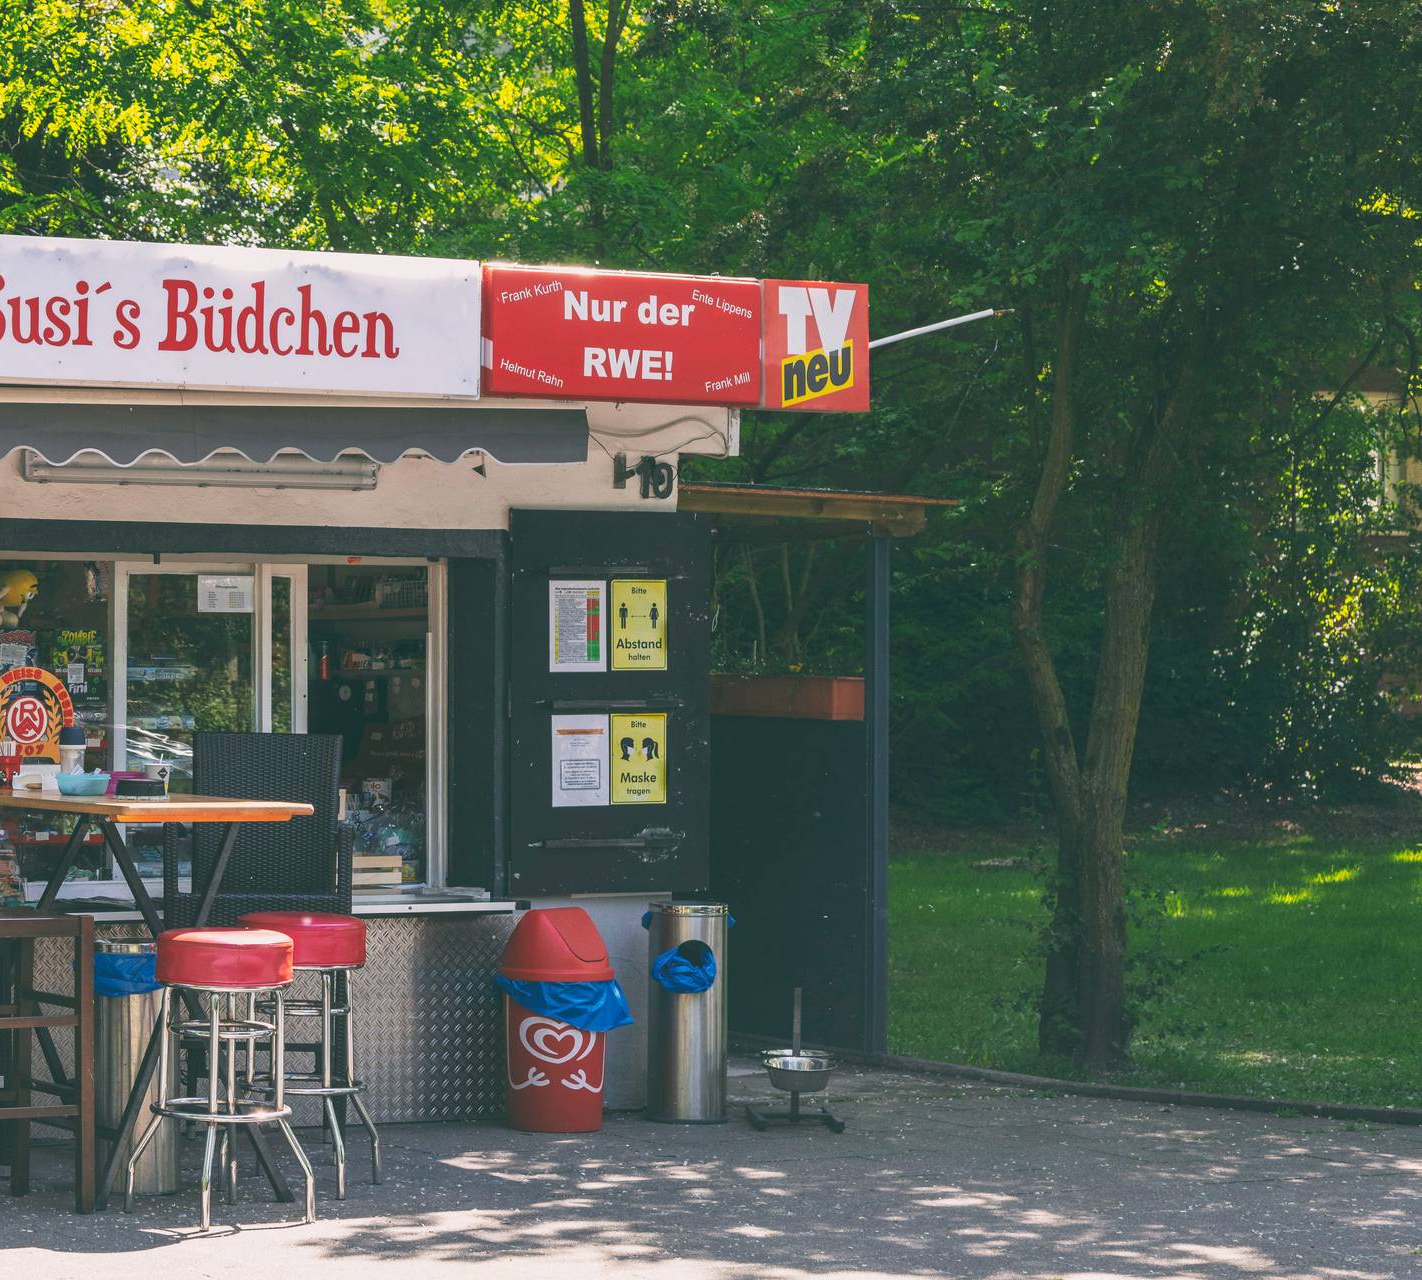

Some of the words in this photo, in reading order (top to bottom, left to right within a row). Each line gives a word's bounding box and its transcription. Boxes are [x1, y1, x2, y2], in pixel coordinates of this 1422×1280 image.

[501, 289, 533, 304] Frank
[534, 280, 563, 297] Kurth
[692, 289, 714, 306] Ente
[716, 297, 753, 319] Lippens
[158, 279, 400, 359] Büdchen
[564, 290, 628, 323] Nur
[638, 294, 695, 327] der
[779, 286, 856, 356] TV
[500, 358, 536, 379] Helmut
[537, 370, 564, 388] Rahn
[583, 347, 673, 381] RWE!
[784, 347, 851, 401] neu
[705, 377, 733, 393] Frank
[734, 371, 751, 386] Mill
[631, 587, 647, 595] Bitte
[616, 637, 662, 649] Abstand
[628, 653, 651, 661] halten
[2, 669, 42, 684] WEISS
[620, 771, 657, 783] Maske
[627, 788, 651, 796] tragen
